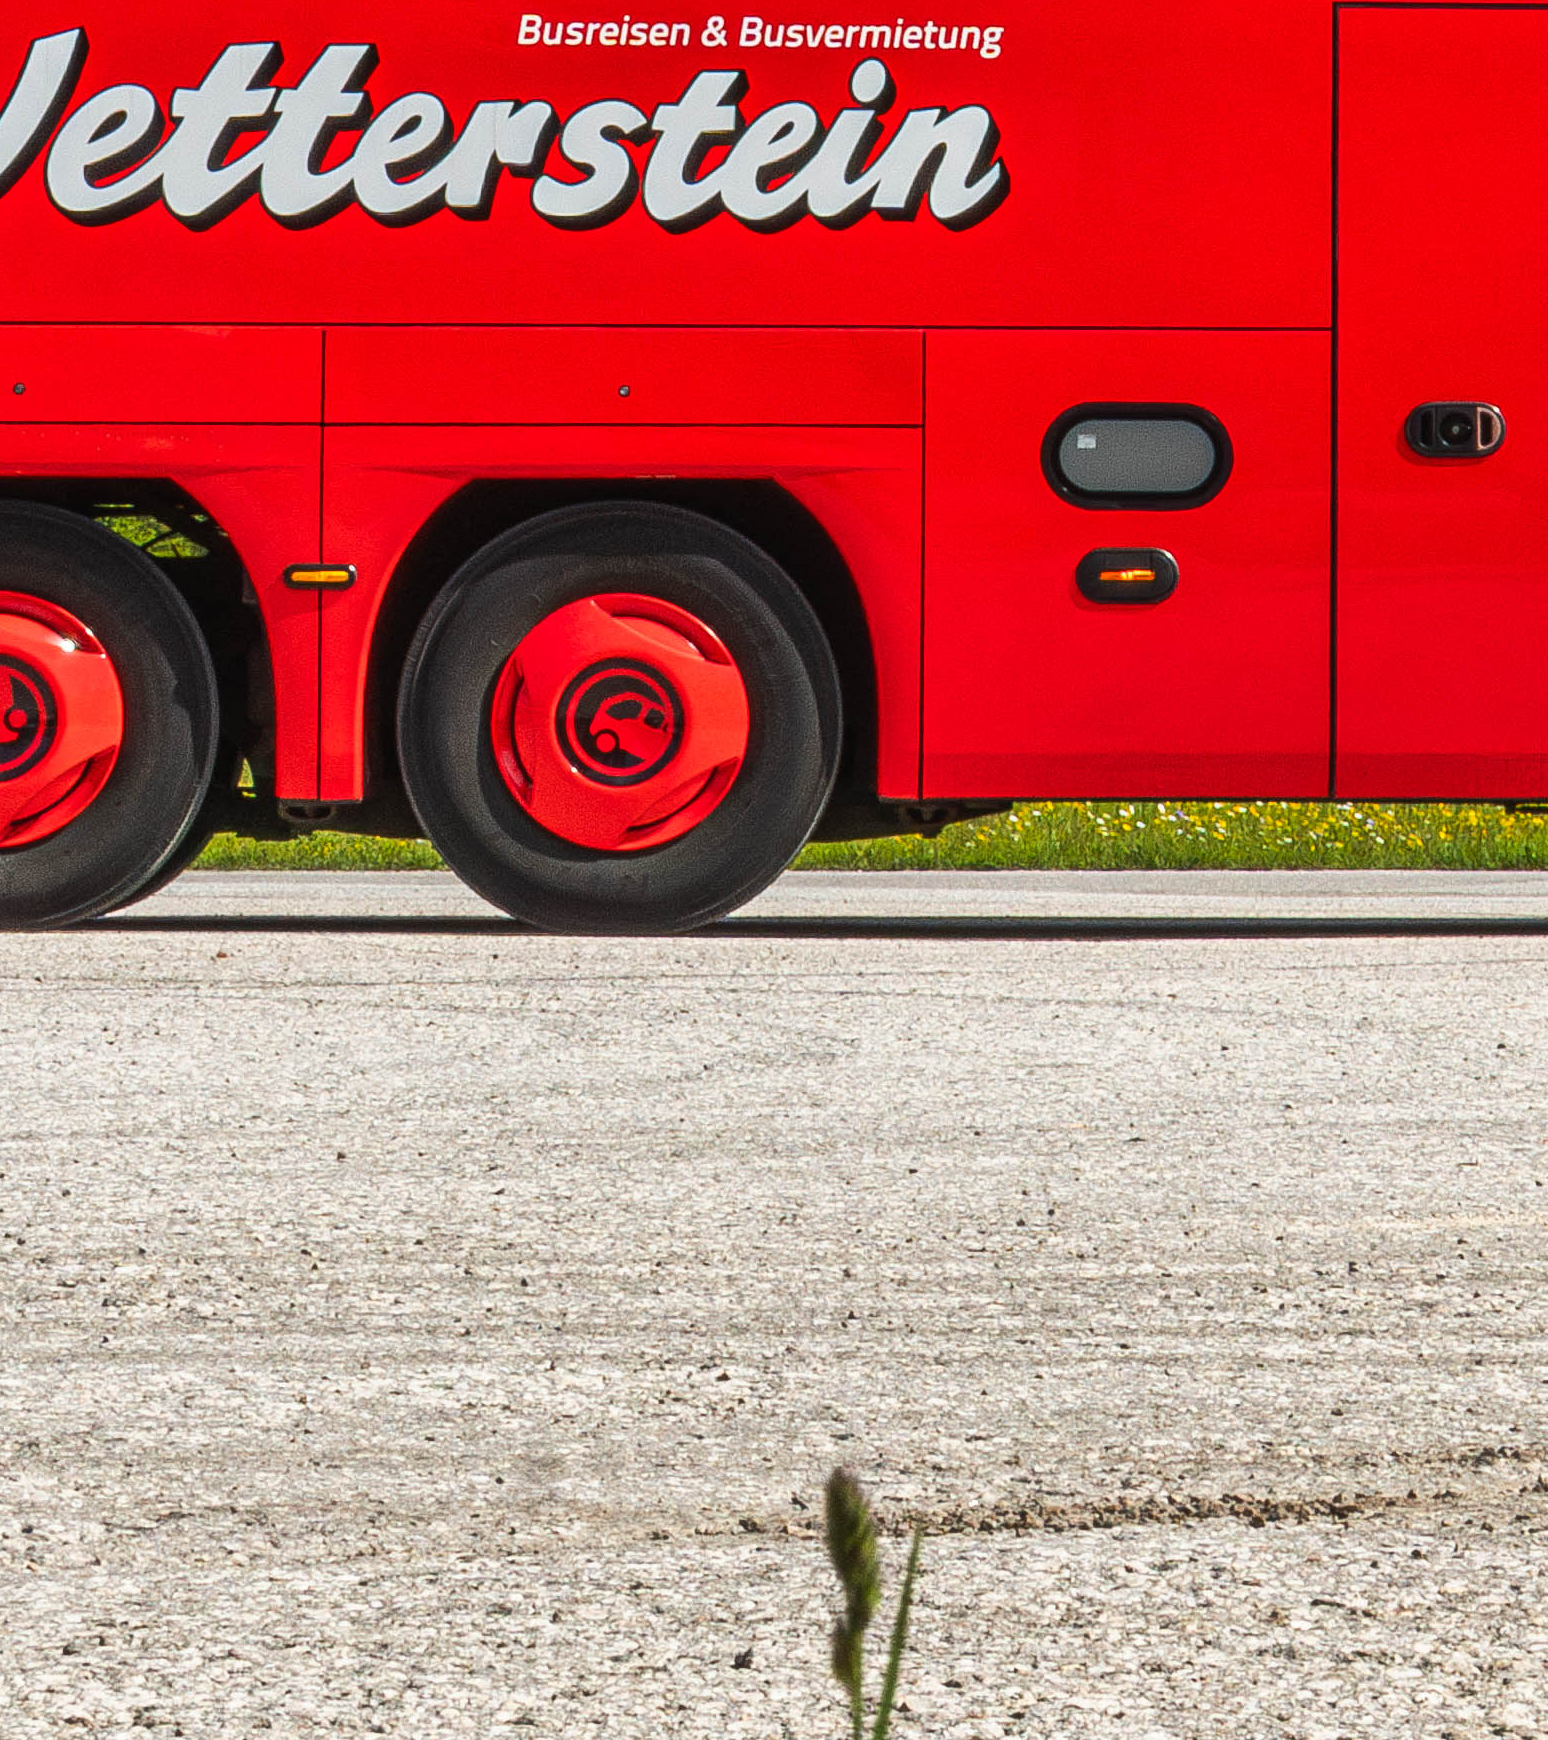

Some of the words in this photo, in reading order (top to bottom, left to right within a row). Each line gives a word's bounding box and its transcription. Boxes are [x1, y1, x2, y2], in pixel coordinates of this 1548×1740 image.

[517, 14, 691, 47] Busreisen
[700, 15, 728, 47] &
[738, 16, 1005, 59] Busvermietung
